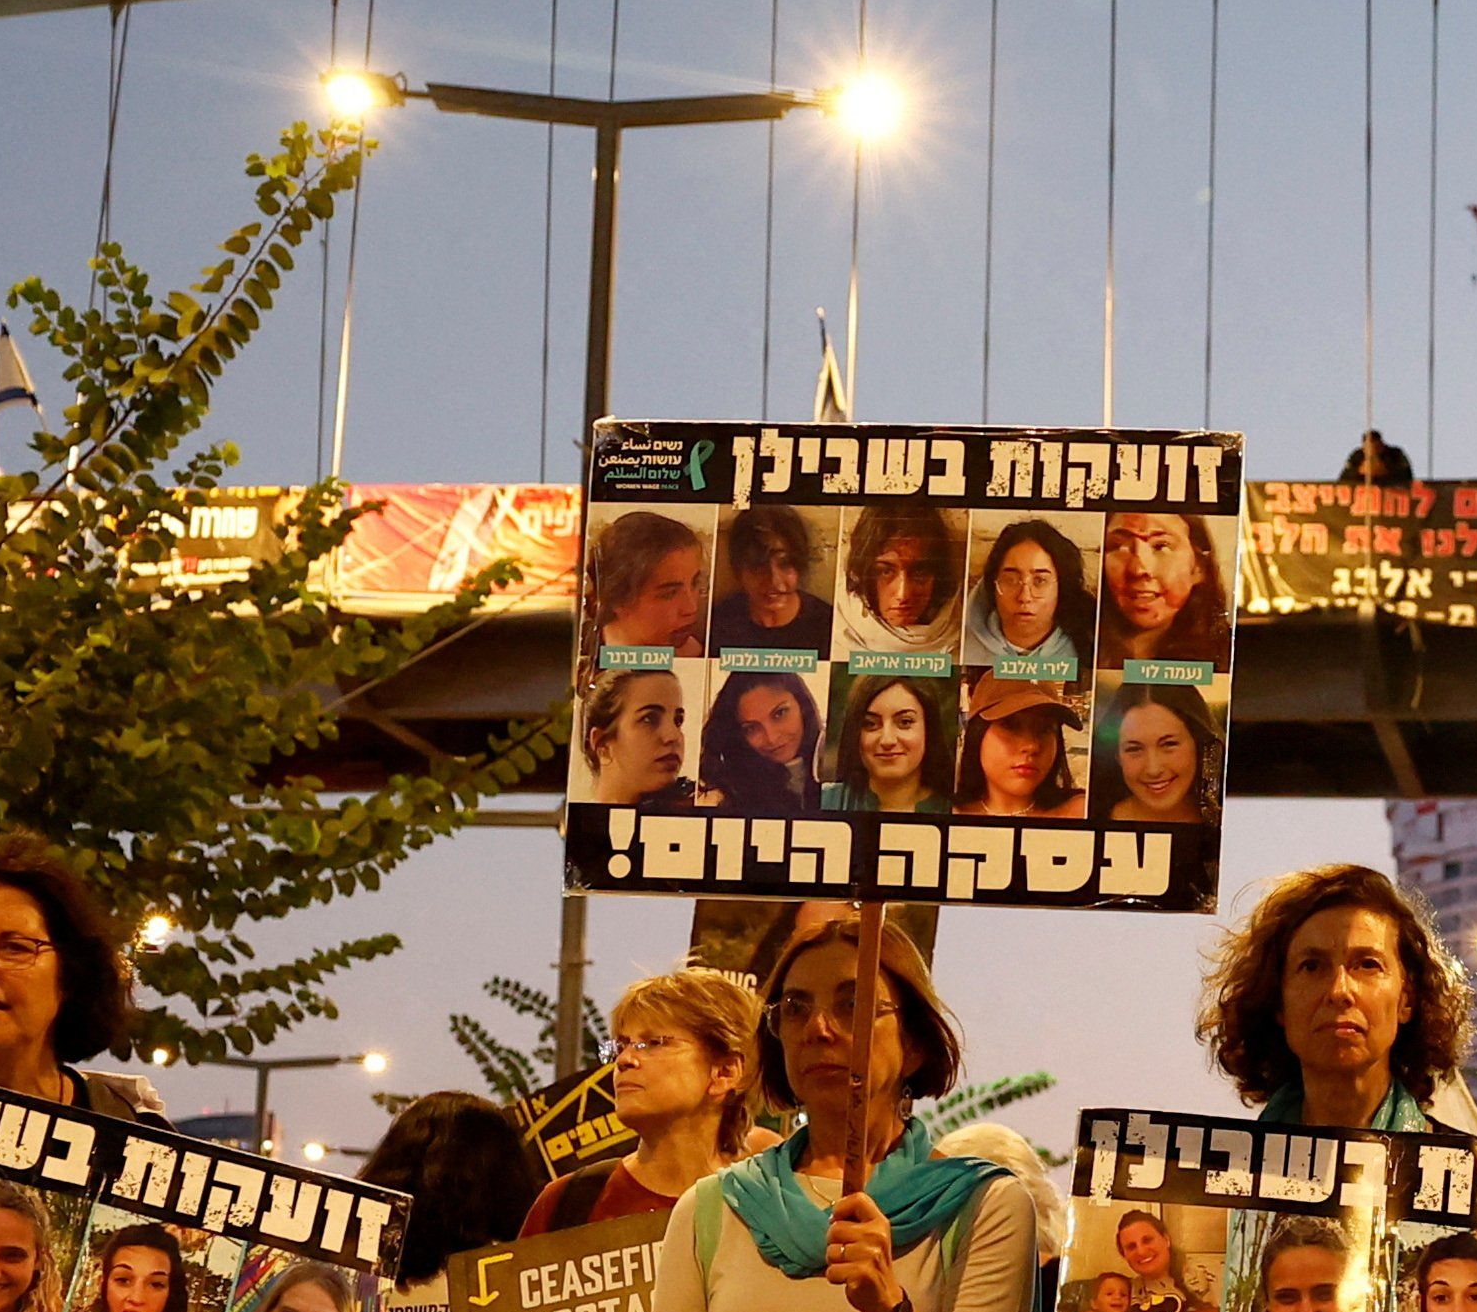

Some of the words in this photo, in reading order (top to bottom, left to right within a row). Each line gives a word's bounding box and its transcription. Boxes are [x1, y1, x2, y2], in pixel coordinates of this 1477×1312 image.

[621, 438, 652, 450] نساء
[653, 440, 683, 451] נשים
[642, 455, 682, 465] עושות
[648, 467, 681, 480] שלום
[732, 428, 967, 510] בשבילן
[987, 439, 1223, 509] זועקות
[1343, 524, 1402, 556] את
[1332, 560, 1432, 599] אלבג
[606, 652, 637, 664] ברנר
[642, 653, 670, 665] אגם
[721, 654, 759, 667] גלבוע
[764, 655, 813, 667] דניאלה
[855, 656, 900, 669] אריאב
[903, 656, 945, 672] קרינה
[1001, 660, 1038, 674] אלבג
[1043, 660, 1070, 675] לירי
[1141, 663, 1161, 679] לוי
[1164, 666, 1203, 680] נעמה
[608, 808, 852, 884] היום!
[879, 823, 1173, 899] עסקה
[1091, 1113, 1387, 1207] בשבילן
[110, 1136, 393, 1261] זועקות
[519, 1243, 663, 1309] CEASEFI
